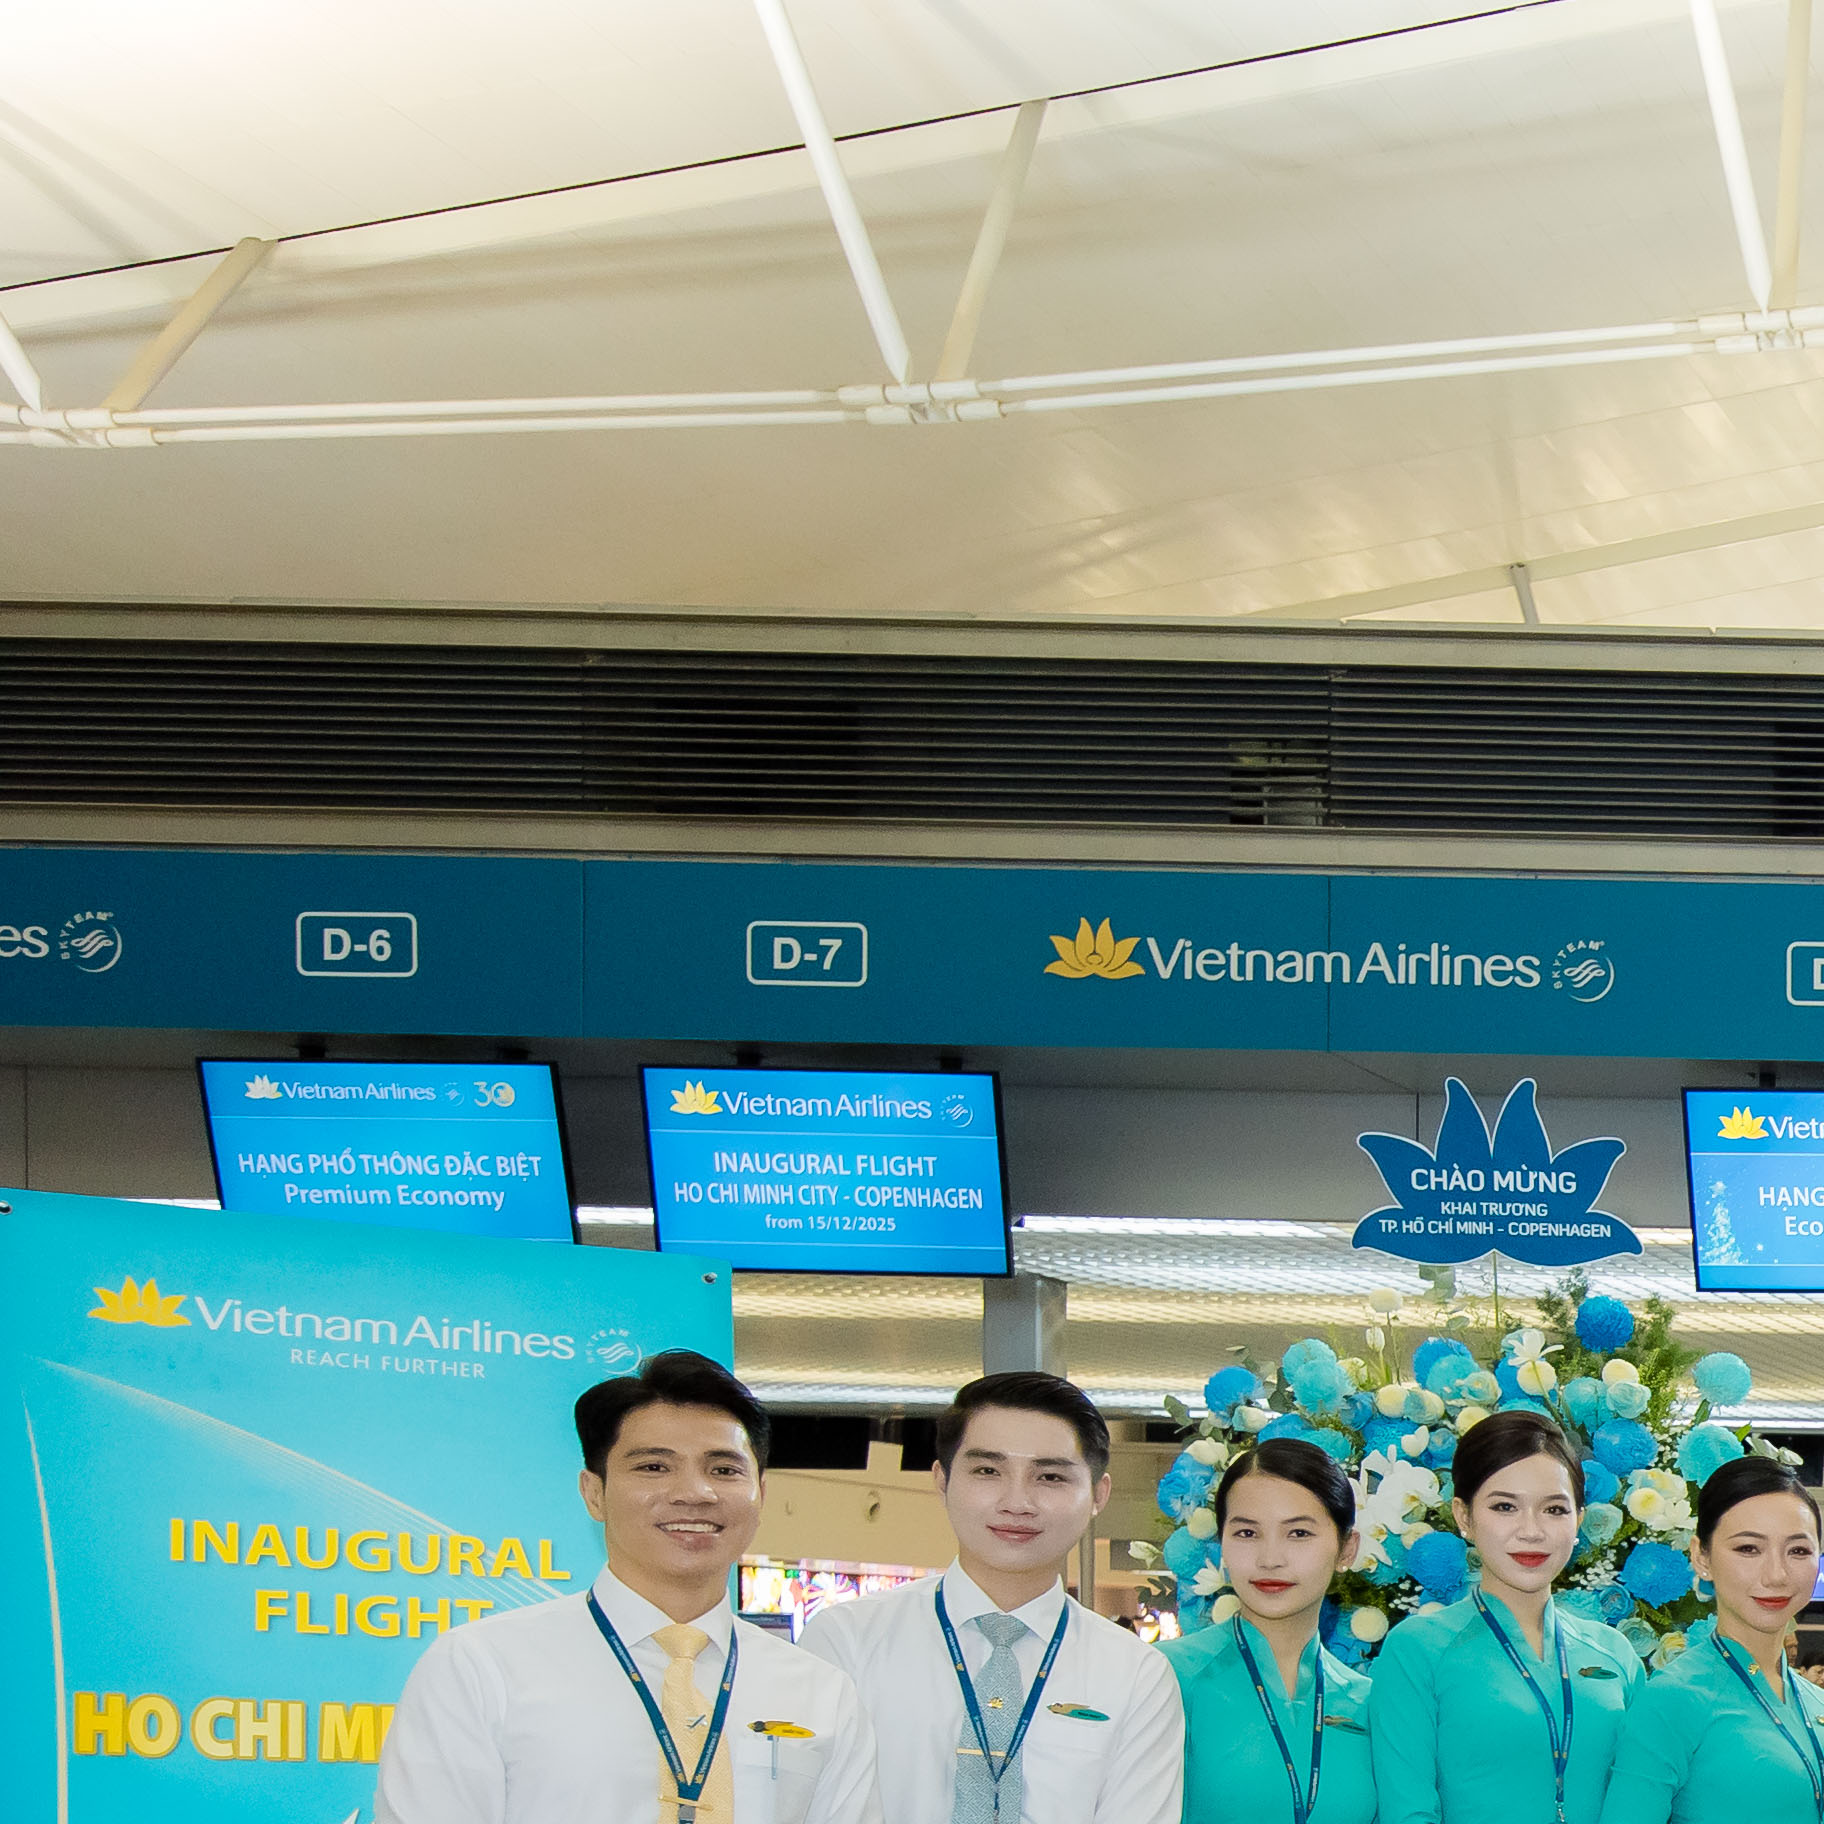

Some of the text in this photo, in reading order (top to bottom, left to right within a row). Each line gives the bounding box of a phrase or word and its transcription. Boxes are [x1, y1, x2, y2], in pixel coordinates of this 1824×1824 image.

[322, 928, 392, 962] D-6
[772, 937, 842, 970] D-7
[1146, 936, 1351, 984] Vietnam
[1355, 942, 1541, 988] Airlines
[283, 1082, 363, 1099] Vietnam
[365, 1083, 436, 1101] Airlines
[721, 1091, 832, 1117] Vietnam
[835, 1094, 932, 1120] Airlines
[238, 1153, 303, 1179] HẠNG
[310, 1148, 354, 1175] PHỔ
[359, 1151, 440, 1175] THÔNG
[497, 1152, 541, 1182] BIỆT
[714, 1151, 937, 1178] INAUGURAL FLIGHT
[1410, 1163, 1577, 1194] CHÀO MỪNG
[284, 1184, 505, 1211] Premium Economy
[674, 1182, 702, 1203] HO
[707, 1183, 740, 1204] CHI
[743, 1184, 794, 1204] MINH
[797, 1185, 838, 1206] CITY
[854, 1185, 982, 1209] COPENHAGEN
[1440, 1200, 1547, 1217] KHAI TRƯƠNG
[765, 1213, 896, 1231] from 15/12/2025
[1378, 1219, 1400, 1234] TP.
[1427, 1216, 1453, 1234] CHÍ
[1456, 1221, 1494, 1235] MINH
[1508, 1222, 1611, 1238] COPENHAGEN
[195, 1296, 396, 1346] Vietnam
[404, 1314, 576, 1361] Airlines
[291, 1348, 486, 1379] REACH FURTHER
[169, 1518, 571, 1580] INAUGURAL
[255, 1589, 494, 1638] FLIGHT
[73, 1691, 181, 1758] HO
[190, 1697, 306, 1762] CHI
